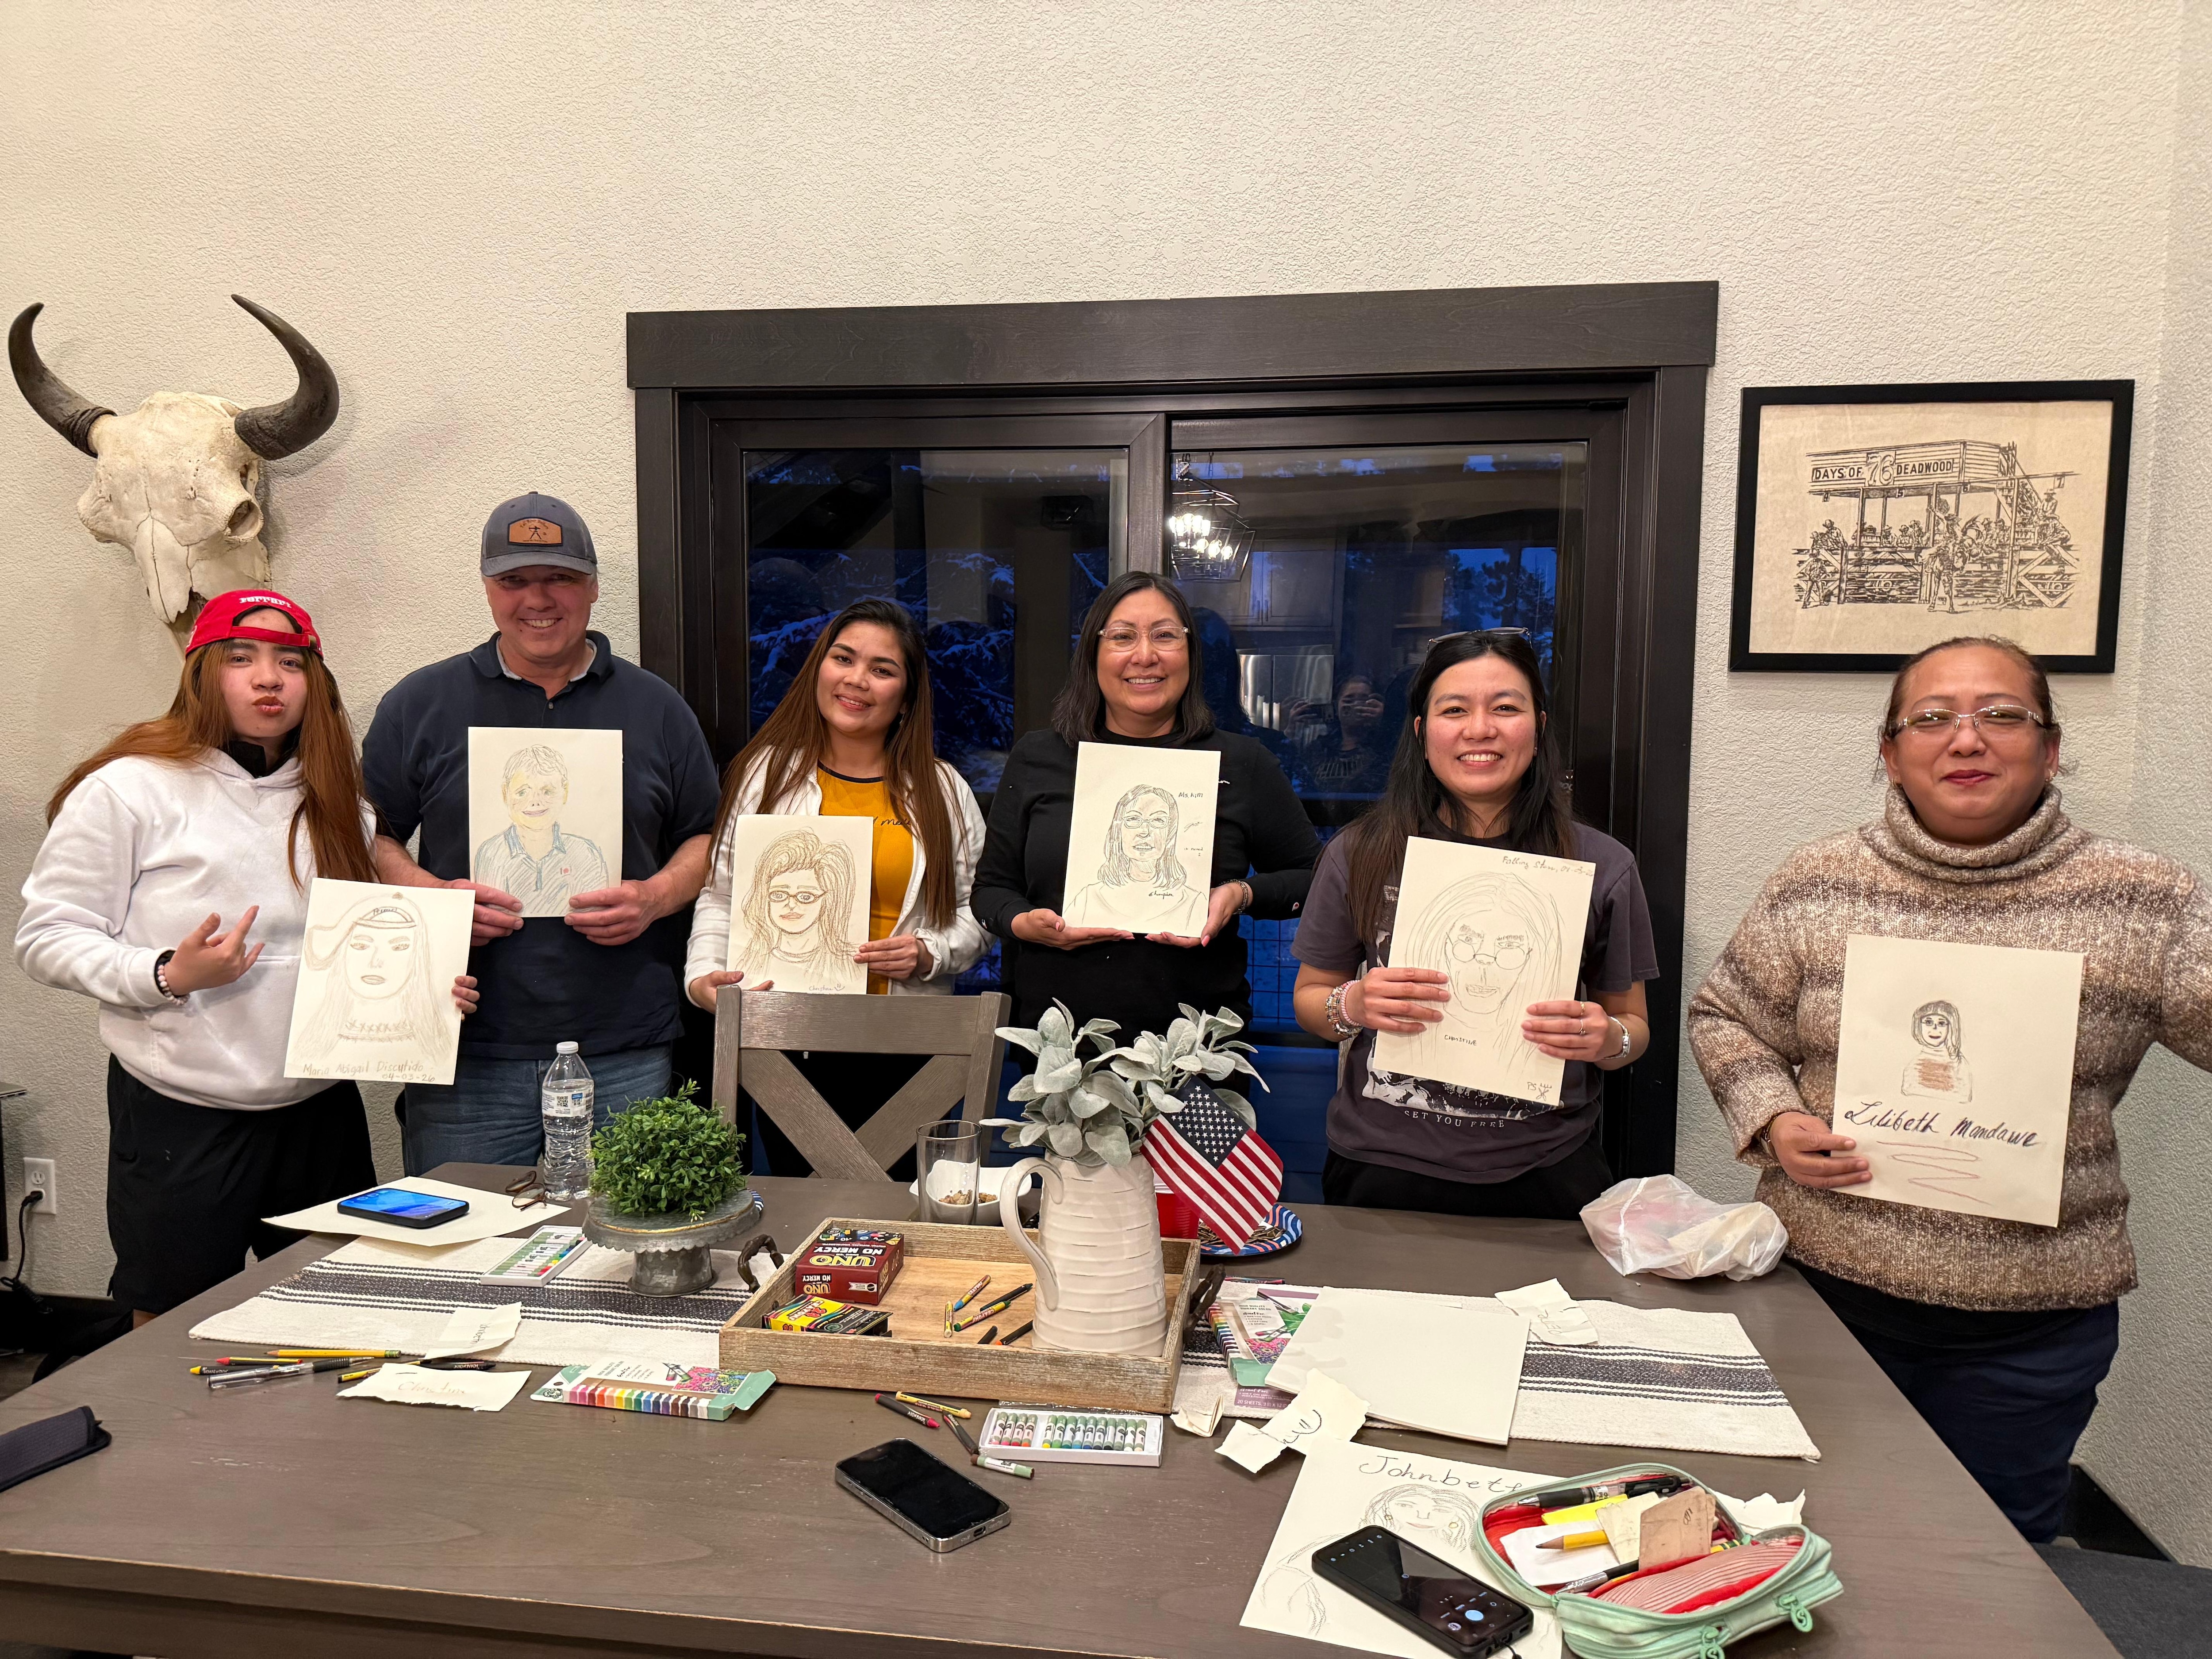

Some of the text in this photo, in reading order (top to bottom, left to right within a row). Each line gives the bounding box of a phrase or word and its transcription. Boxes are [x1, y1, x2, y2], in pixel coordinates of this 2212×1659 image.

[1815, 454, 1952, 486] DAYS OF 76 DEADWOOD
[239, 596, 292, 609] Ferrari
[303, 1064, 330, 1076] Maria
[335, 1061, 370, 1076] Abigail
[1404, 1110, 1429, 1119] SET
[1436, 1114, 1462, 1127] YOU
[1844, 1101, 1941, 1133] Lilibeth
[809, 1255, 876, 1267] UNO
[803, 1283, 831, 1294] UNO
